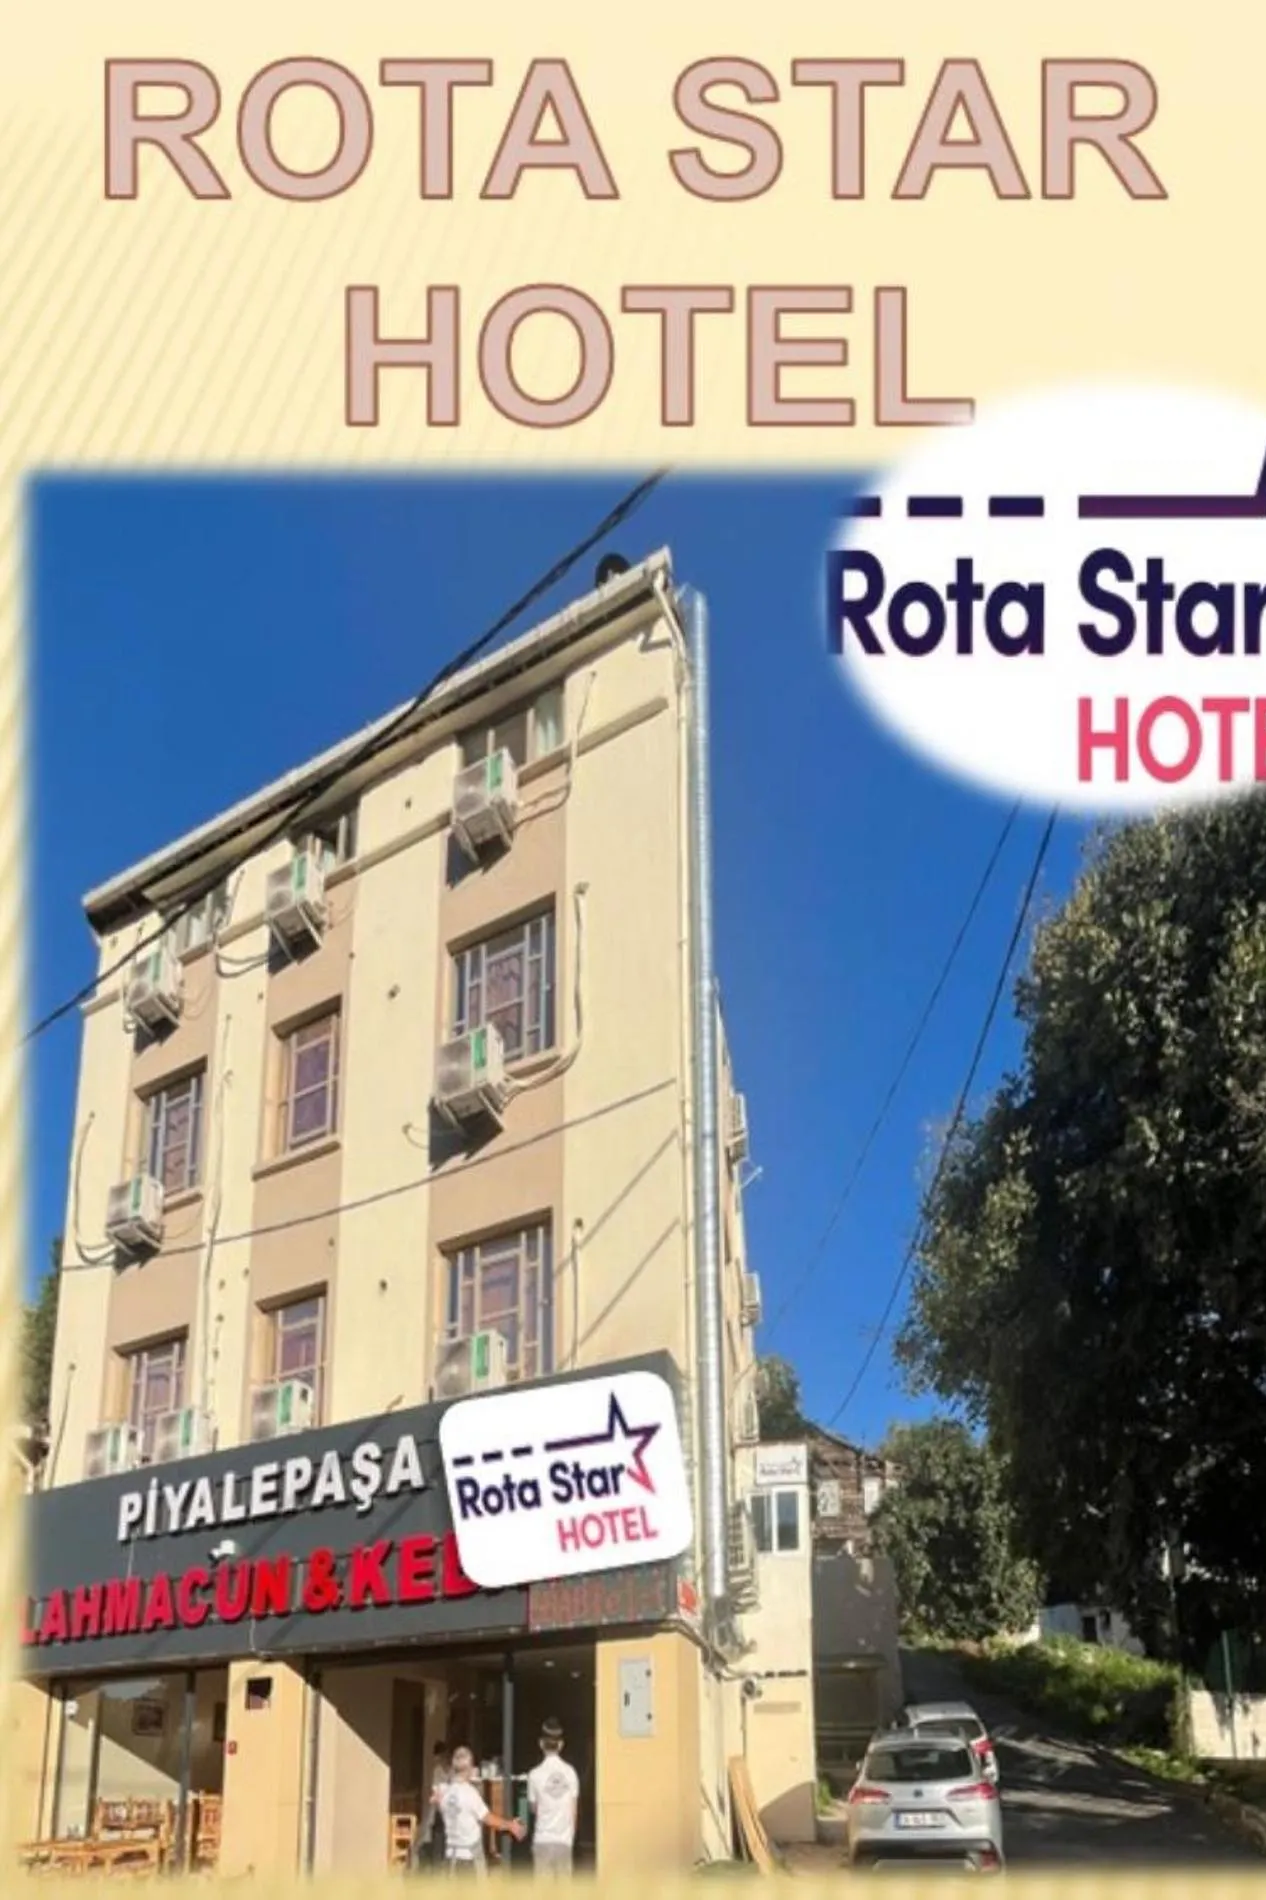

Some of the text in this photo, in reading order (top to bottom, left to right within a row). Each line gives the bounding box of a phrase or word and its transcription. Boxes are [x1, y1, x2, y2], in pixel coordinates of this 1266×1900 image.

[116, 1434, 426, 1541] PİYALEPAŞA
[456, 1460, 626, 1520] Rota Star
[556, 1504, 660, 1553] HOTEL
